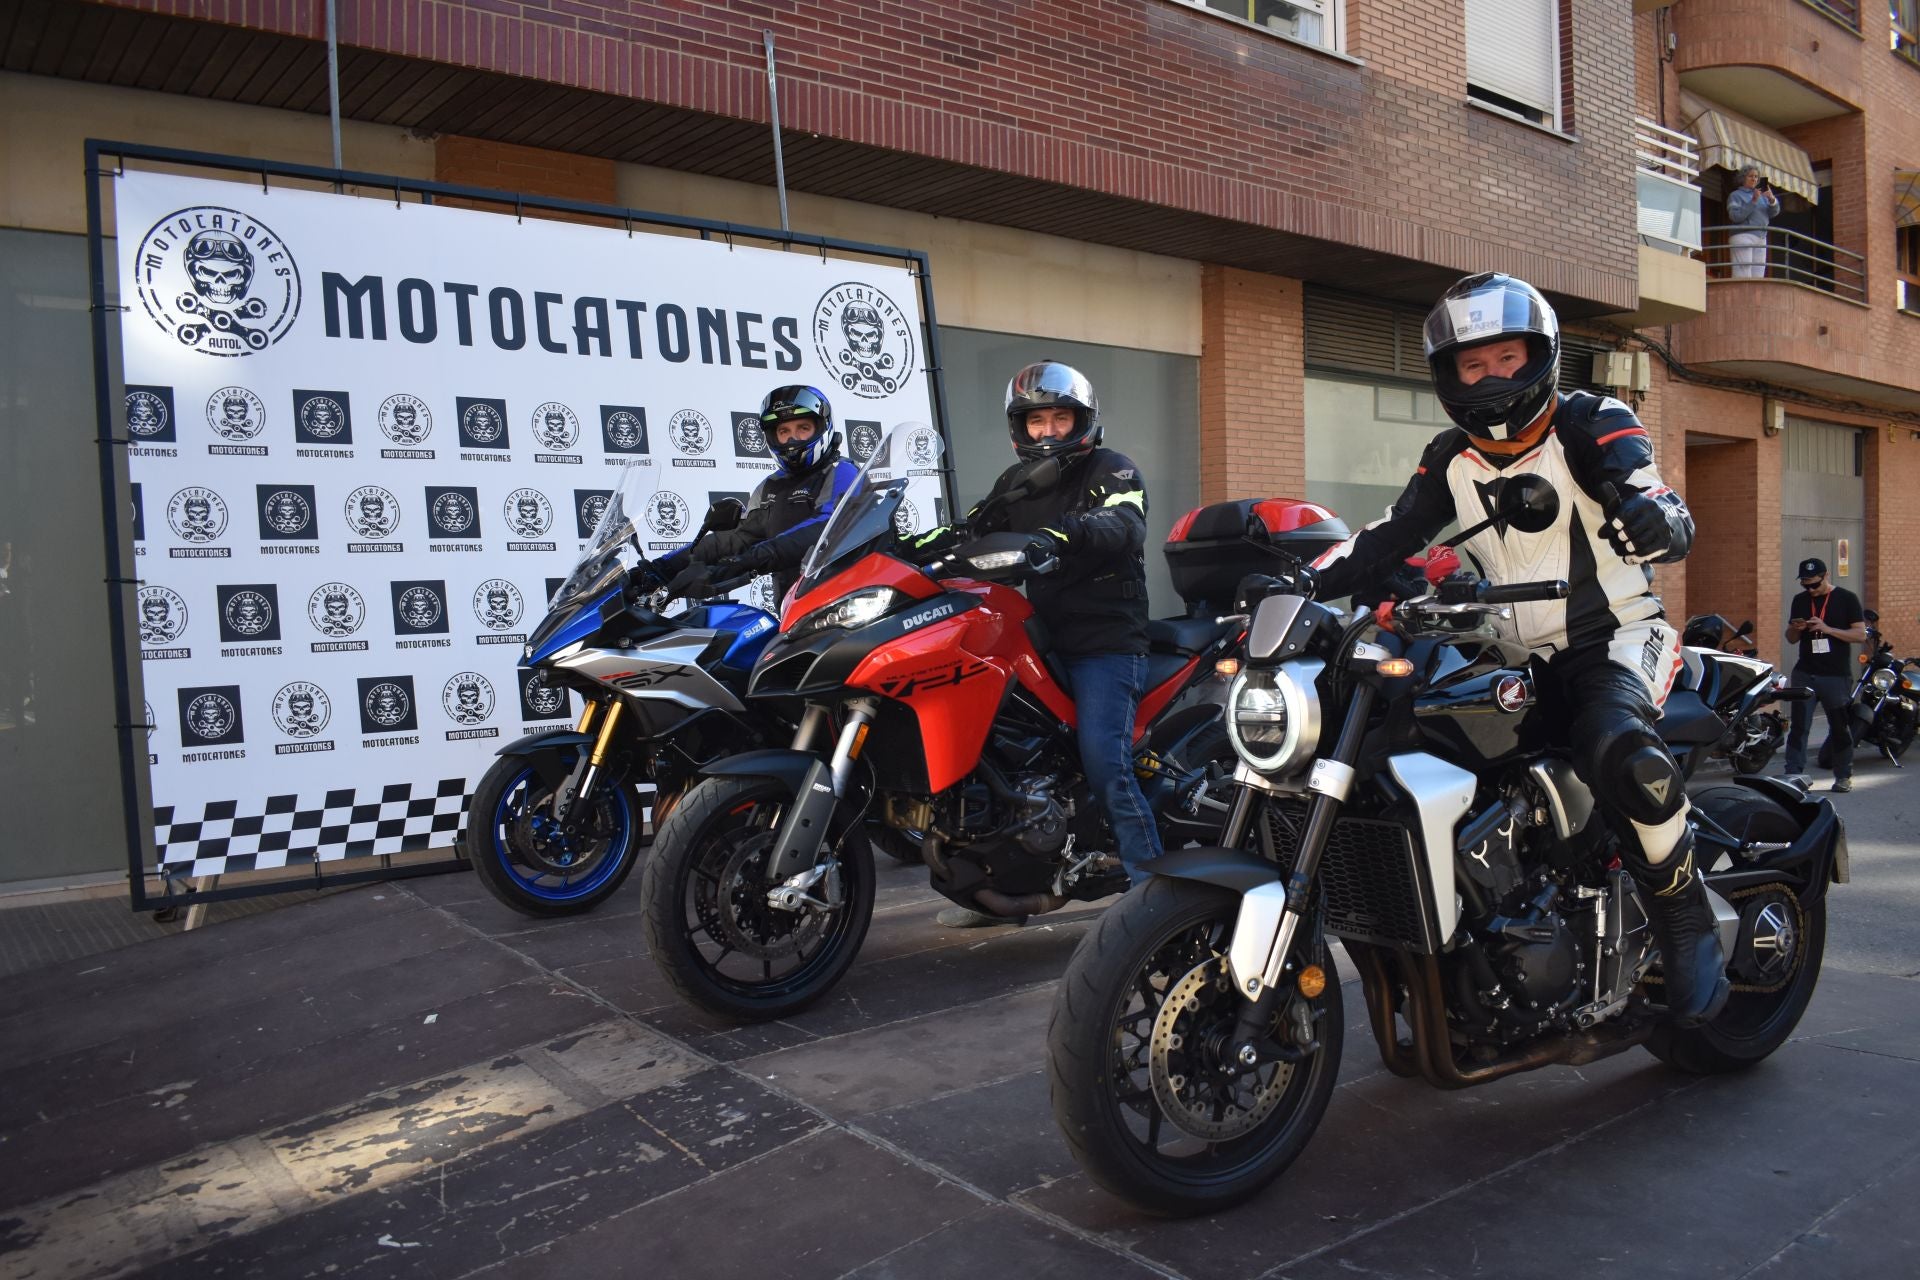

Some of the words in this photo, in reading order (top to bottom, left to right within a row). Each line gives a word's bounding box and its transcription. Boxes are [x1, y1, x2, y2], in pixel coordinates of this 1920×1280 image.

[145, 214, 290, 278] MOTOCATONES
[818, 288, 907, 337] MOTOCATONES
[321, 271, 802, 372] MOTOCATONES
[208, 337, 241, 350] AUTOL
[129, 448, 178, 458] TOCATONES
[211, 445, 266, 455] MOTOCATONES
[296, 449, 354, 458] MOTOCATONES
[383, 450, 432, 459] MOTOCATONES
[460, 453, 511, 463] MOTOCATONES
[536, 455, 581, 464] MOTOCATONES
[674, 459, 715, 468] MOTOCATONES
[172, 549, 229, 557] MOTOCATONES
[260, 545, 320, 555] MOTOCATONES
[350, 544, 401, 552] MOTOCATONES
[429, 544, 483, 553] MOTOCATONES
[902, 603, 954, 630] DUCATI
[396, 638, 451, 649] MOTOCATONES
[479, 635, 525, 644] MOTOCATONES
[221, 646, 283, 657] MOTOCATONES
[313, 641, 366, 652] MOTOCATONES
[142, 649, 188, 658] TOCATONES
[448, 729, 497, 740] MOTOCATONES
[362, 735, 420, 748] MOTOCATONES
[278, 742, 332, 753] MOTOCATONES
[182, 750, 246, 763] MOTOCATONES
